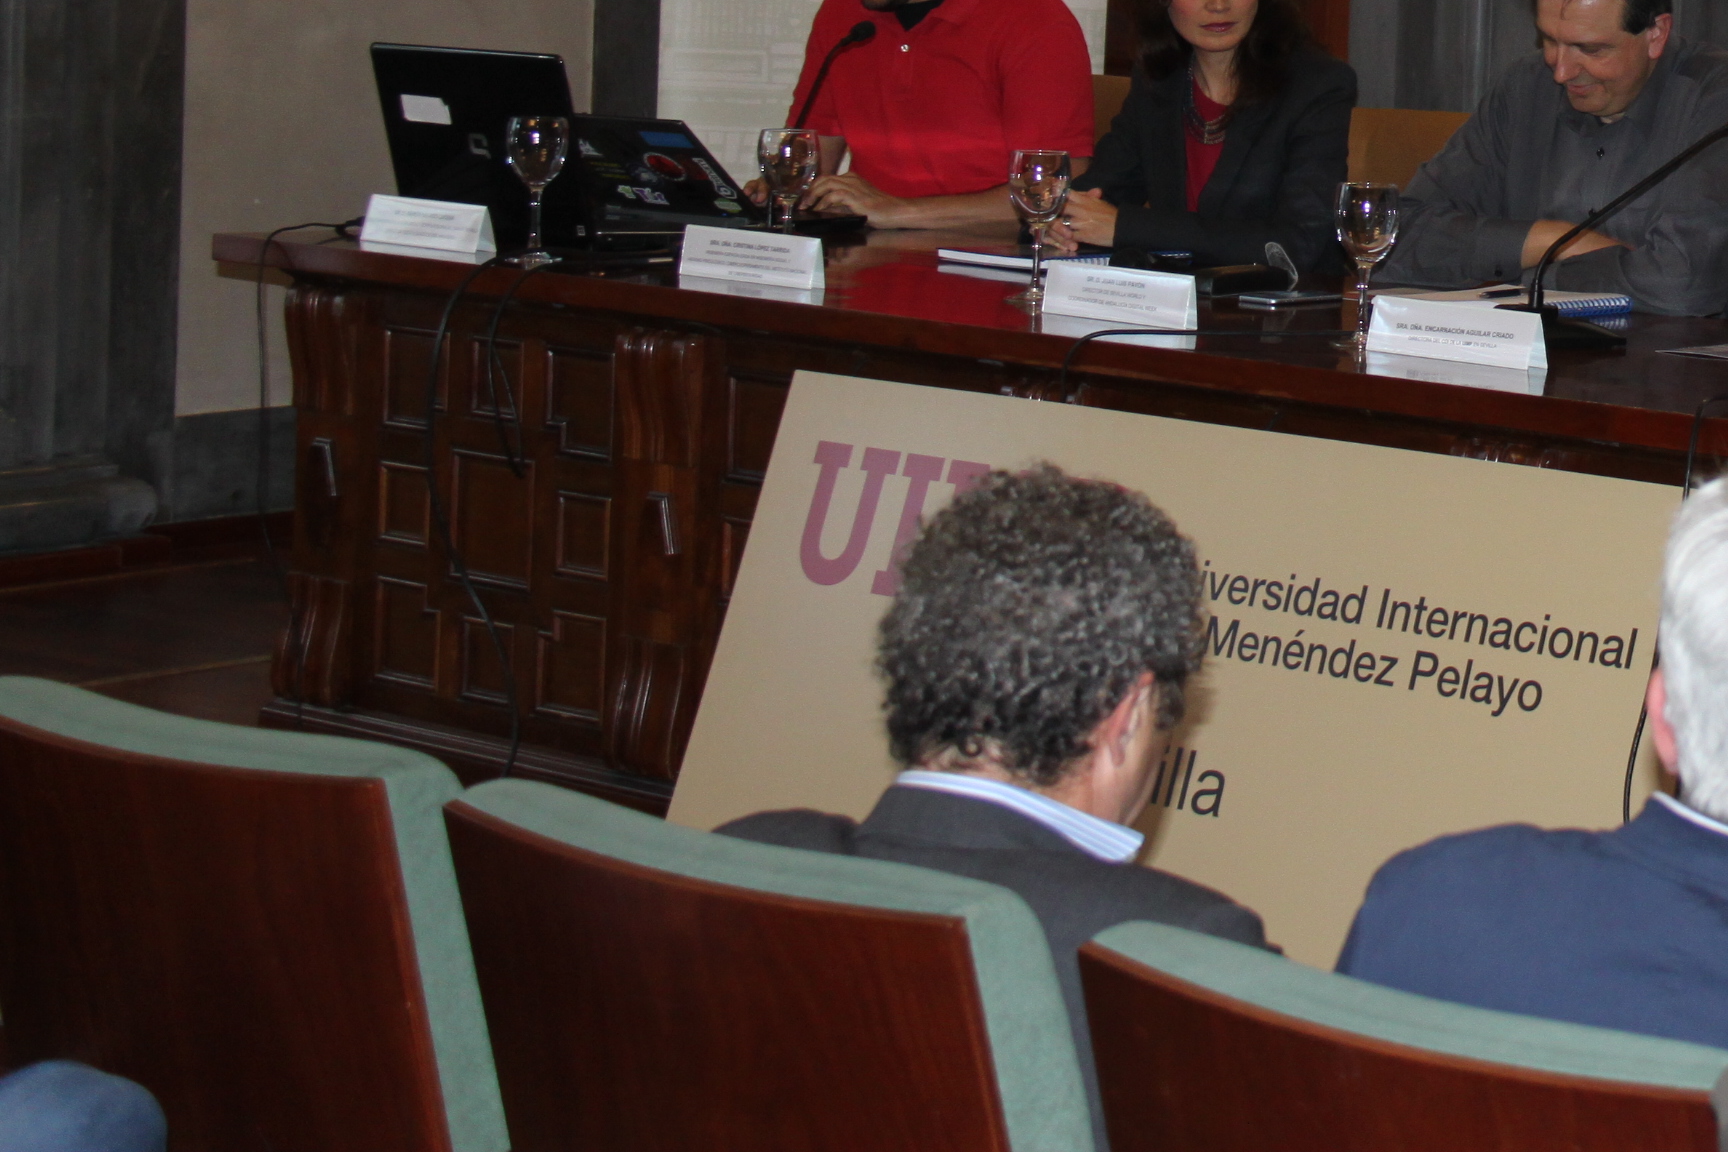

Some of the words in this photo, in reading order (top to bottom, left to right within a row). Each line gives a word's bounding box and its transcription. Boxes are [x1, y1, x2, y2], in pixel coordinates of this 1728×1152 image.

[1466, 329, 1491, 338] AGUILAR
[1492, 330, 1515, 340] CRIADO
[1200, 560, 1369, 625] iversidad
[1376, 588, 1639, 669] Internacional
[1204, 616, 1399, 687] Menéndez
[1408, 650, 1543, 717] Pelayo
[1150, 745, 1226, 818] illa
